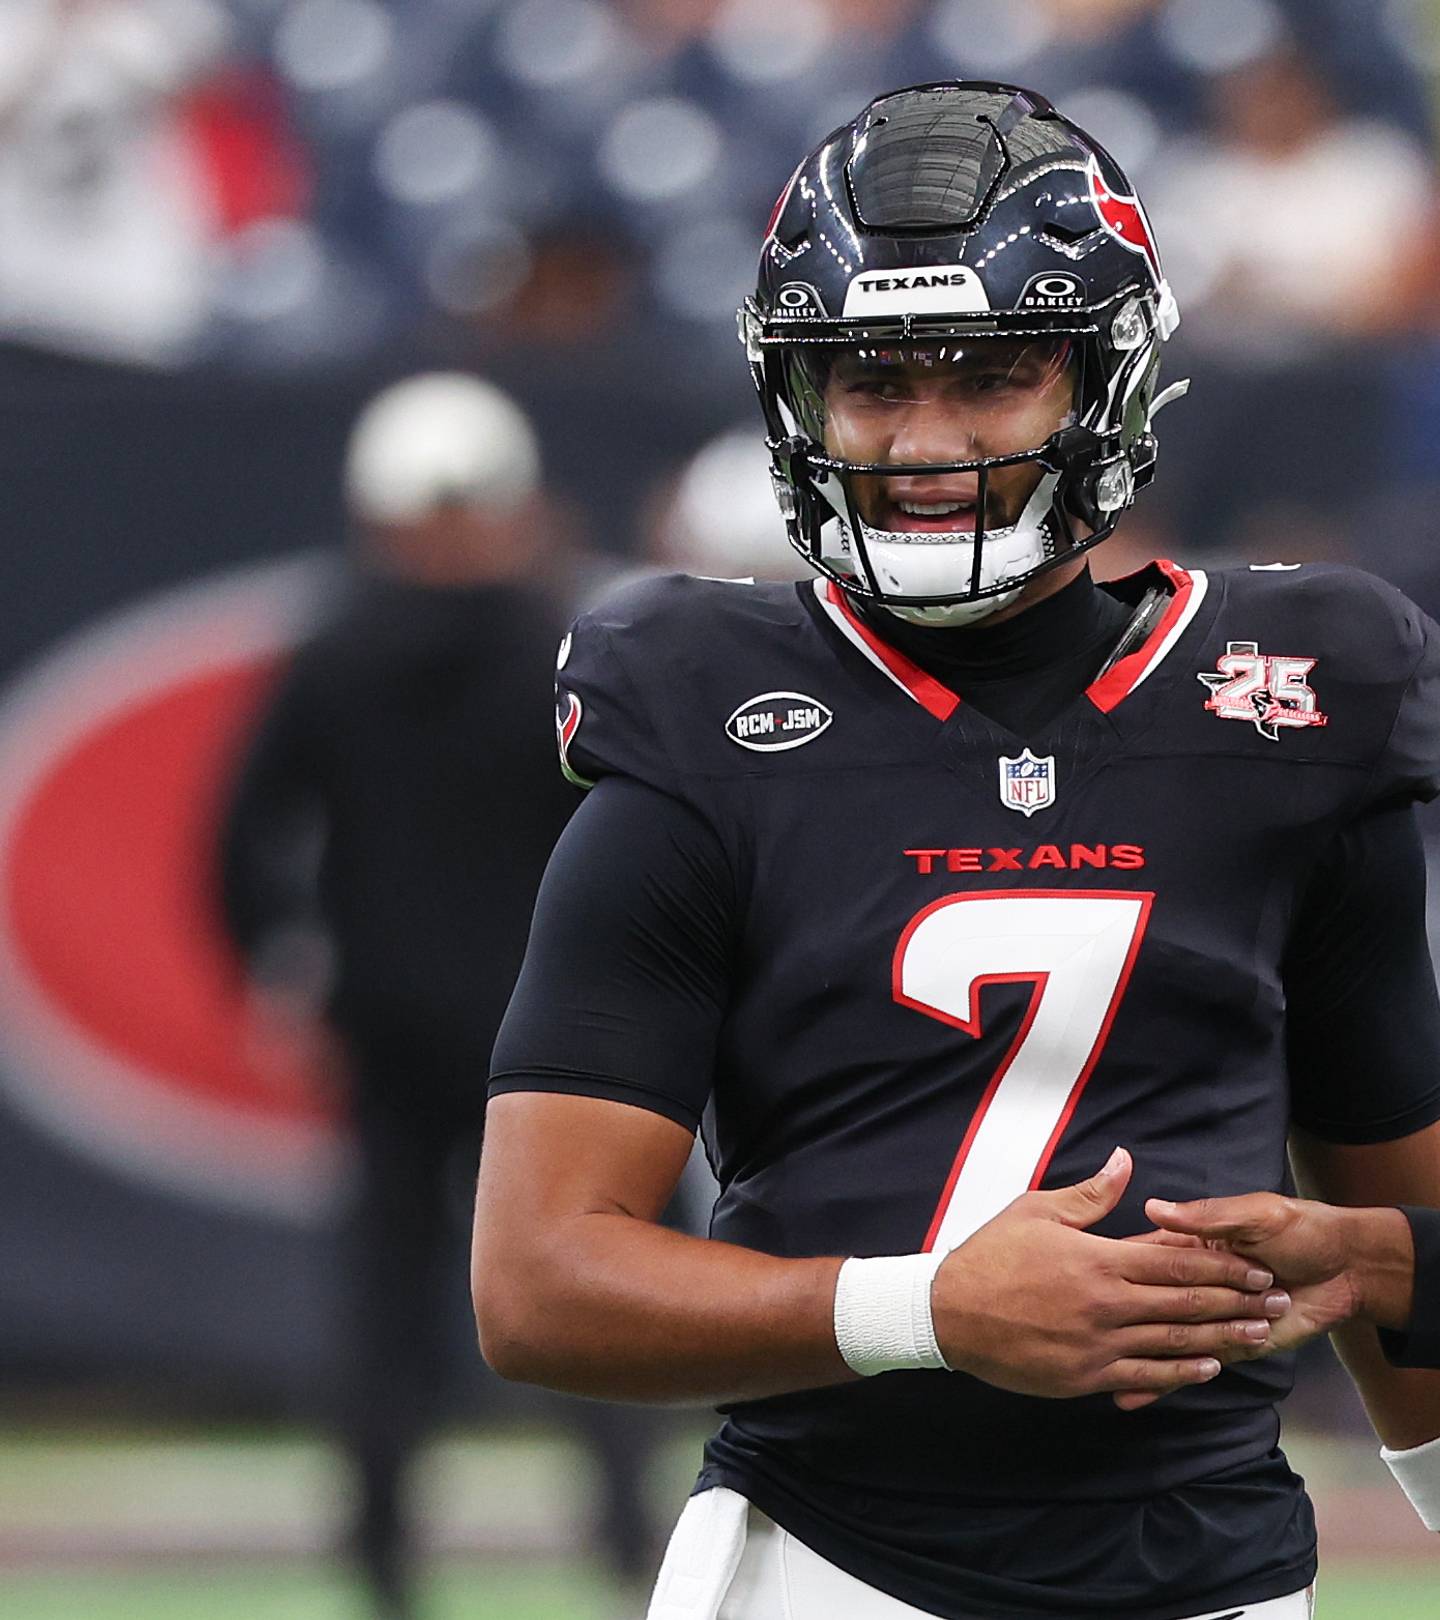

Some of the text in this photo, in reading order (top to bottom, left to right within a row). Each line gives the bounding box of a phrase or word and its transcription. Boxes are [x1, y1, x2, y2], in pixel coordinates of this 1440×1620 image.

[858, 273, 967, 293] TEXANS
[776, 307, 817, 317] OAKLEY
[1025, 297, 1083, 306] OAKLEY
[1216, 654, 1318, 714] 25
[736, 708, 820, 738] RCM JSM
[1010, 780, 1046, 804] NFL
[902, 843, 1145, 875] TEXANS
[893, 888, 1155, 1253] 7
